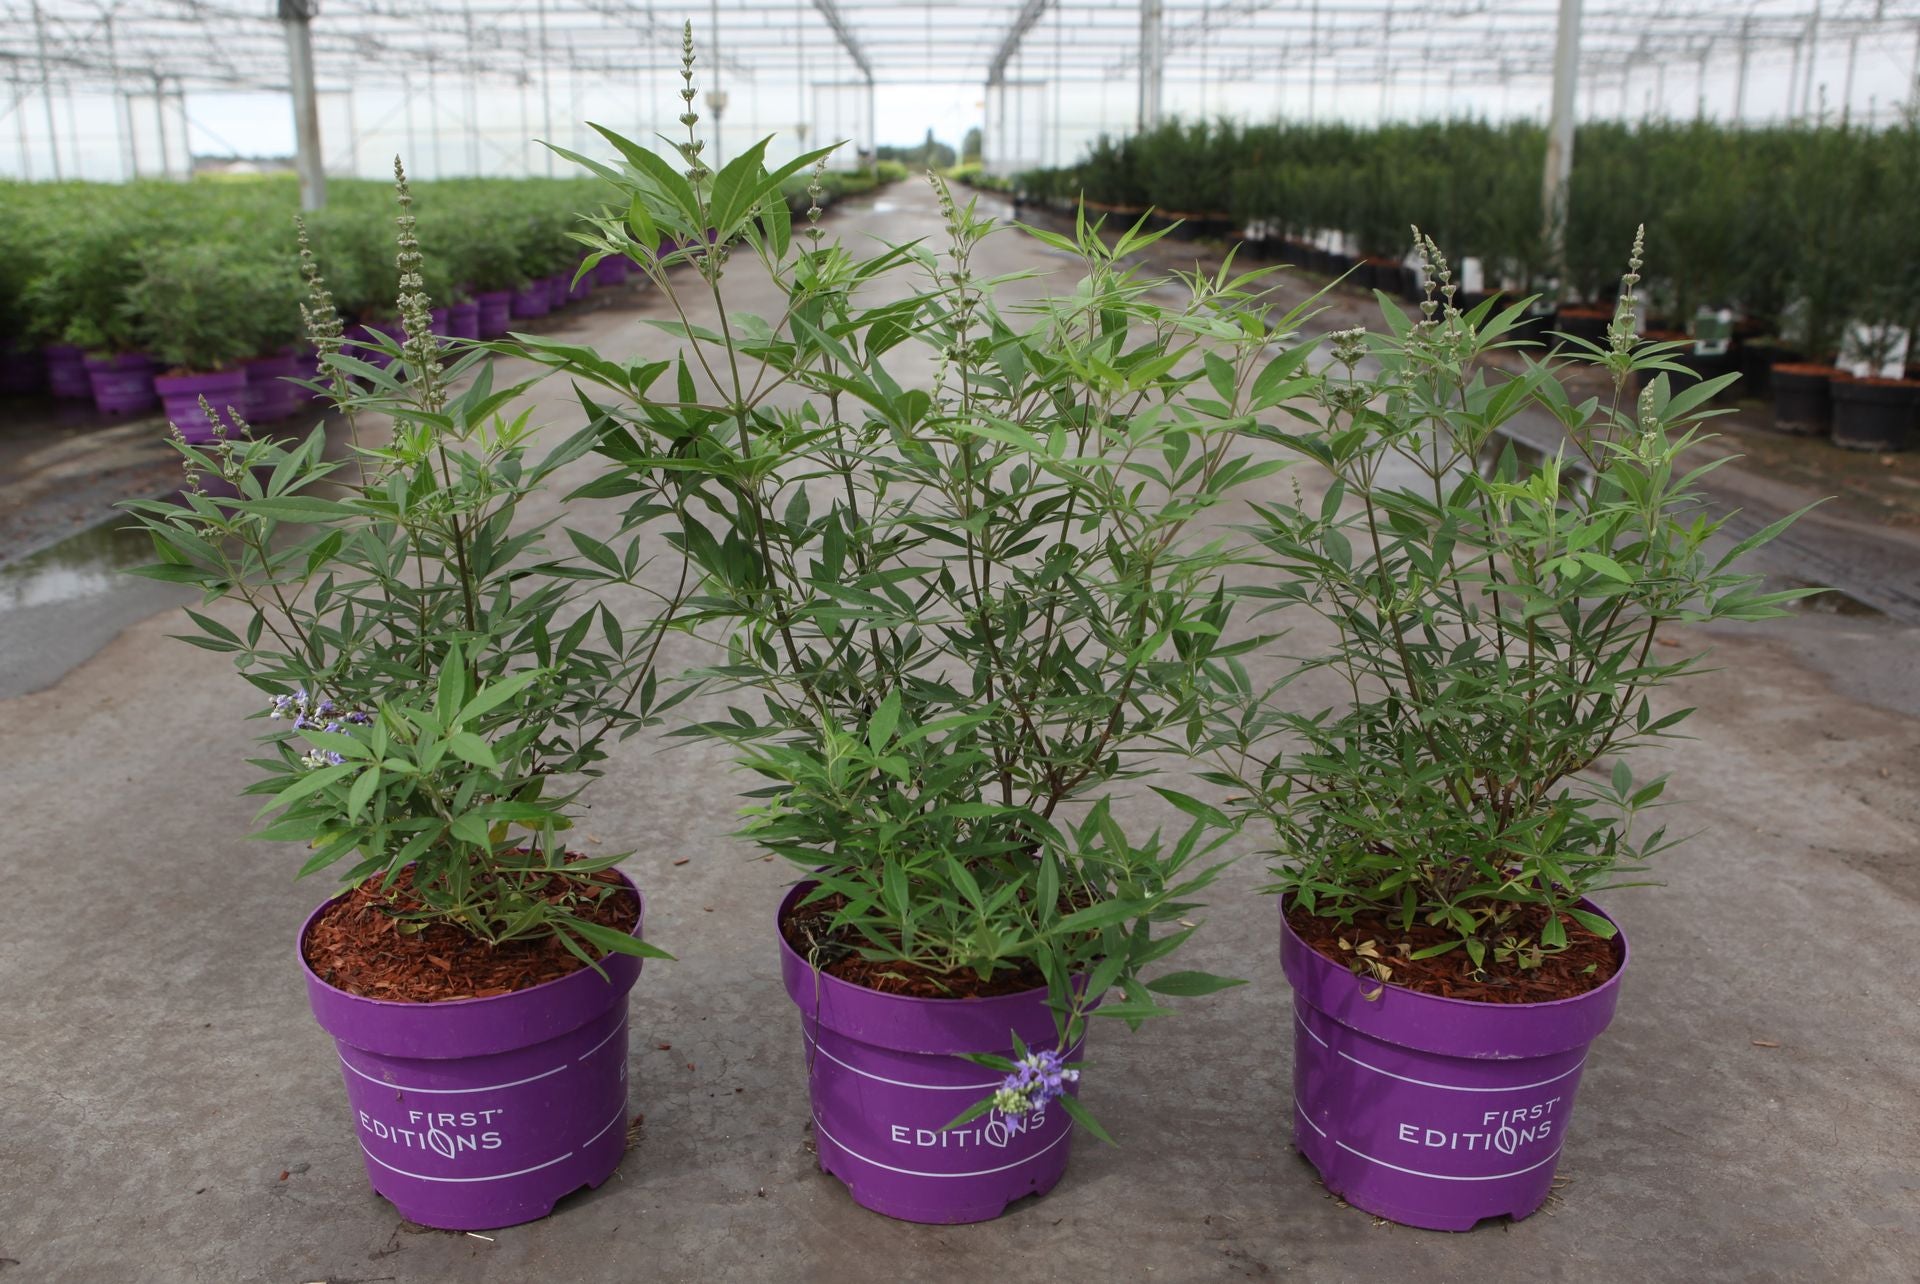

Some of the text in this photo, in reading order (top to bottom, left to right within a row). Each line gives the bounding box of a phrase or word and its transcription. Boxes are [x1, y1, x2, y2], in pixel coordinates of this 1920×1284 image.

[359, 1110, 502, 1159] EDITIONS
[891, 1111, 1045, 1147] EDITIONS
[1399, 1120, 1552, 1154] EDITIONS
